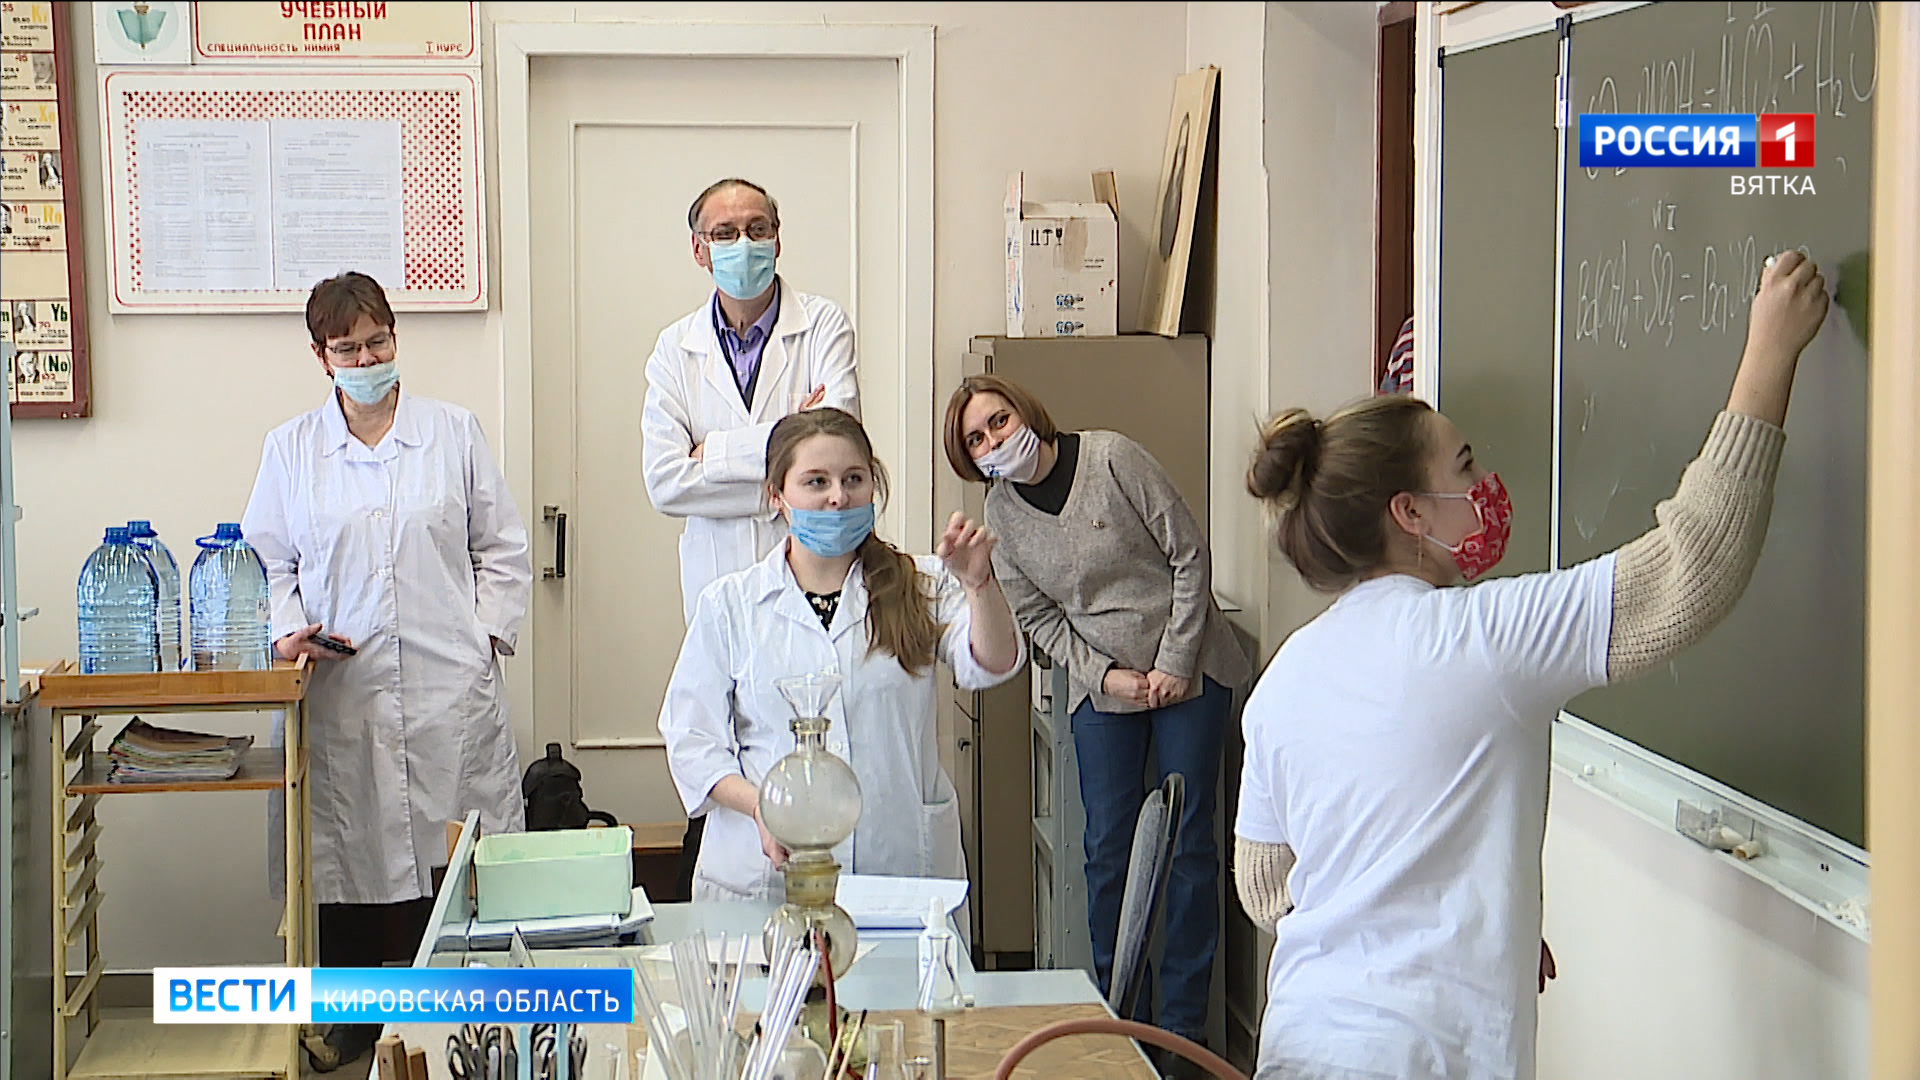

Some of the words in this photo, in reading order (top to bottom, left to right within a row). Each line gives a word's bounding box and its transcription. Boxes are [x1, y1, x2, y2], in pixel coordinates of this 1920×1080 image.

[280, 1, 388, 19] УЧЕБНЫЙ
[303, 23, 362, 41] ПЛАН
[207, 43, 299, 53] СПЕЦИАЛЬНОСТЬ
[304, 43, 342, 53] ХИМИЯ
[51, 303, 68, 322] Yb
